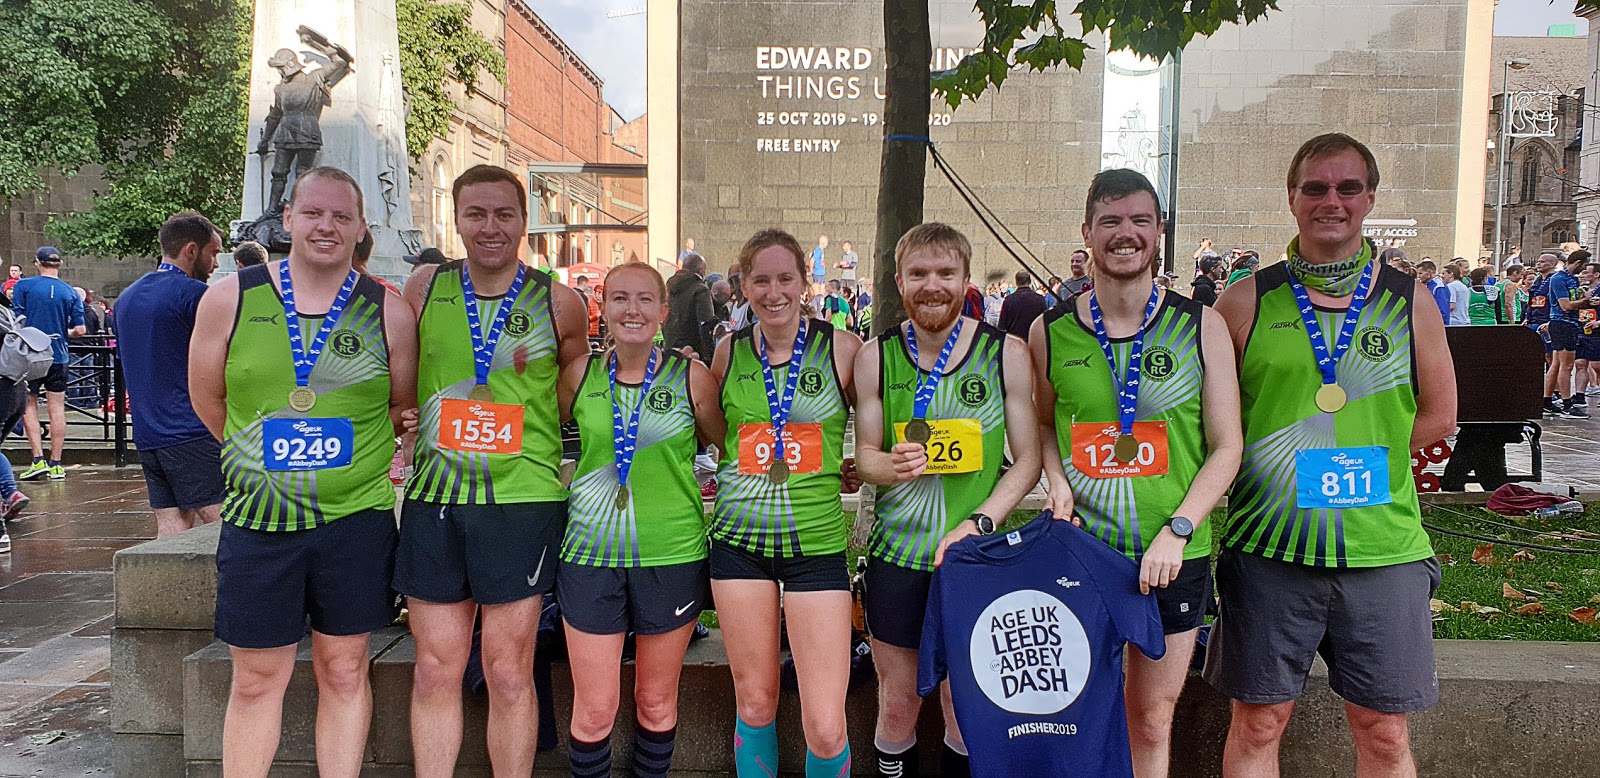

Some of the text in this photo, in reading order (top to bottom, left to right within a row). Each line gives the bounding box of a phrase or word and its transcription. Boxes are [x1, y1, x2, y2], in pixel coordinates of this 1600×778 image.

[756, 46, 872, 70] EDWARD
[756, 76, 860, 100] THINGS
[757, 112, 775, 125] 25
[778, 112, 809, 125] OCT
[812, 112, 846, 126] 2019
[862, 112, 877, 126] 19
[756, 138, 841, 152] FREE ENTRY
[1363, 229, 1418, 237] LIFT ACCESS
[1291, 254, 1360, 274] GRANTHAM
[511, 313, 524, 326] G
[510, 324, 524, 333] RC
[339, 334, 354, 346] G
[1367, 332, 1382, 347] G
[339, 346, 355, 354] RC
[1367, 345, 1384, 356] RC
[1151, 352, 1165, 366] G
[1151, 366, 1167, 375] RC
[804, 372, 817, 385] G
[805, 384, 818, 392] RC
[966, 379, 980, 393] G
[654, 390, 667, 402] G
[966, 393, 981, 402] RC
[653, 401, 668, 410] RC
[451, 418, 513, 444] 1554
[272, 437, 342, 461] 9249
[460, 441, 497, 451] #AbbeyDash
[755, 442, 802, 465] 93
[1084, 441, 1155, 468] 120
[288, 460, 328, 468] #AbbeyDash
[926, 464, 958, 472] AbbeyDash
[1099, 467, 1141, 475] #AbbeyDash
[1321, 470, 1371, 497] 811
[1328, 496, 1369, 505] #AbbeyDash
[990, 605, 1060, 633] AGE UK
[991, 624, 1062, 656] LEEDS
[1000, 647, 1063, 675] ABBEY
[1000, 667, 1069, 700] DASH
